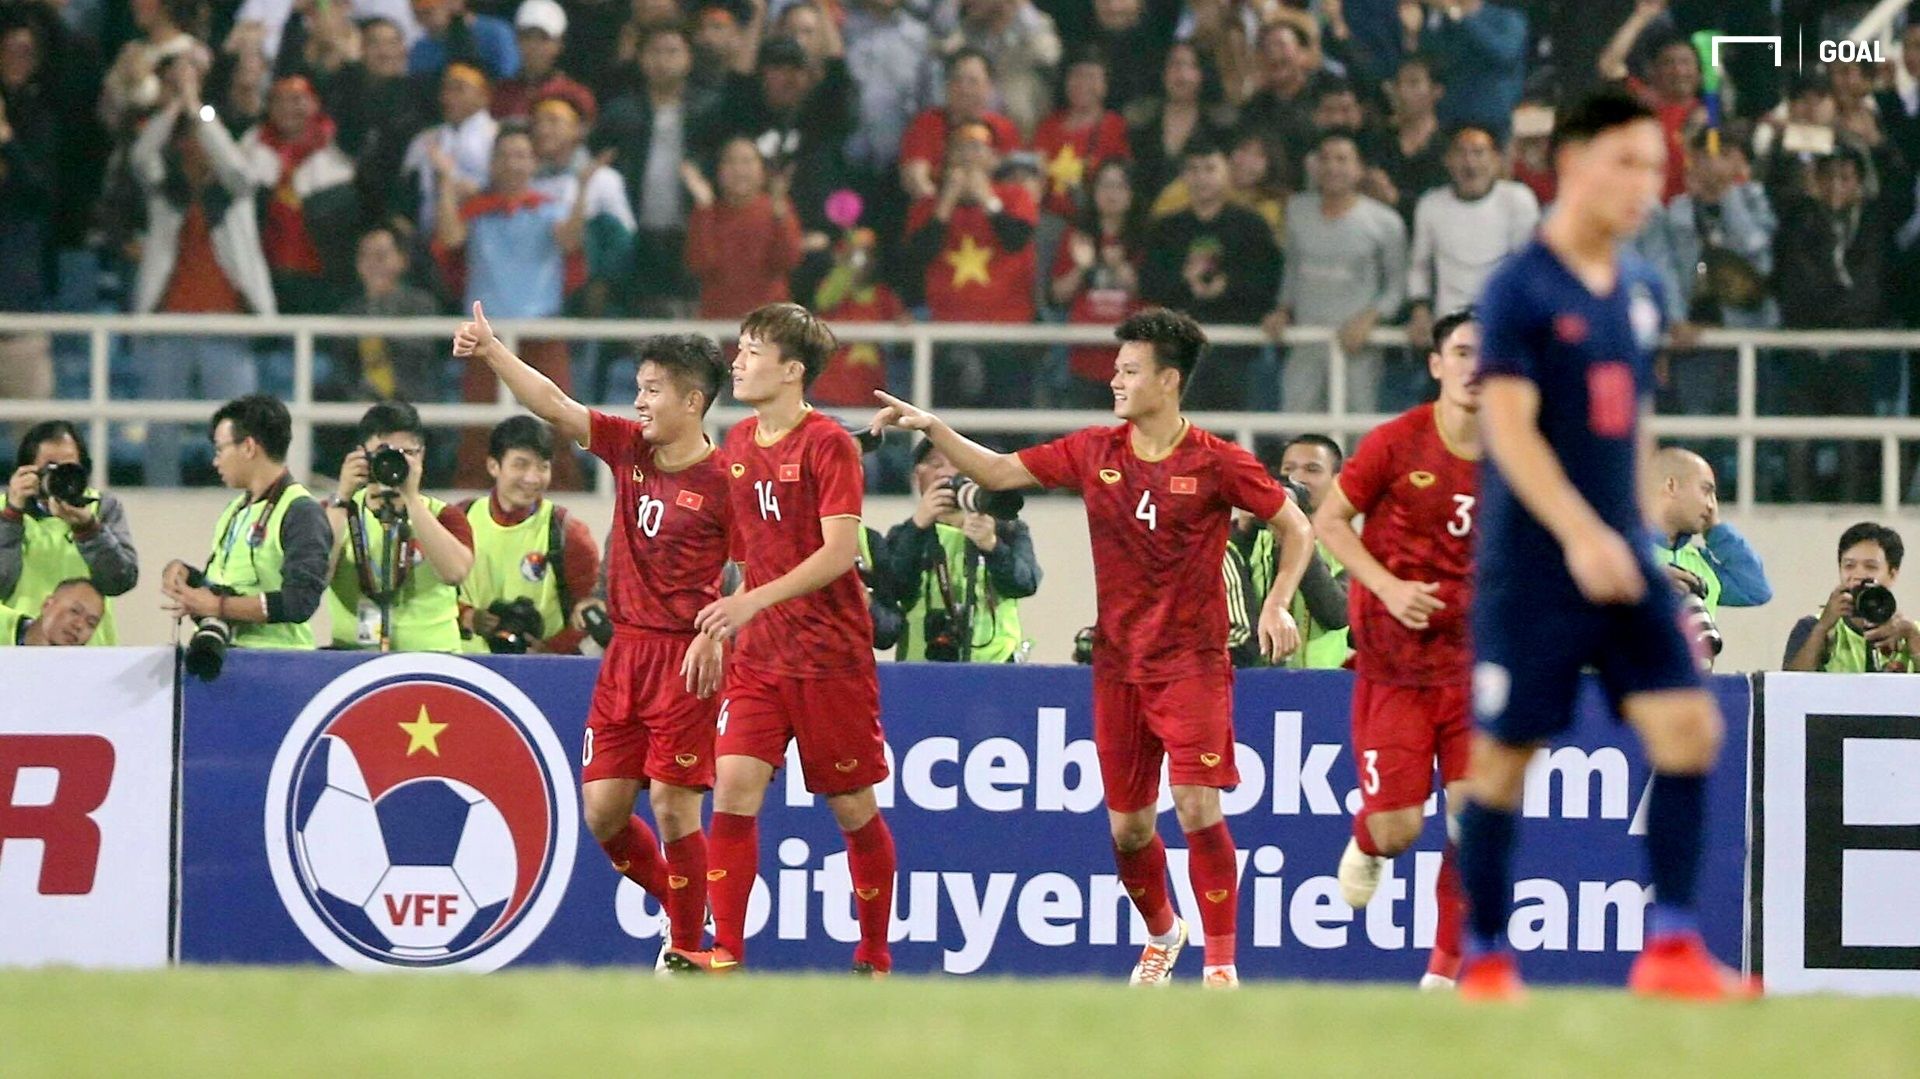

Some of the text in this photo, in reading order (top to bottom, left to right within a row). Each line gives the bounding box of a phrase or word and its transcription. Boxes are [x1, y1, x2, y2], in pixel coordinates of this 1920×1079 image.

[637, 494, 665, 538] 10
[754, 480, 782, 522] 14
[1135, 490, 1156, 530] 4
[1447, 493, 1476, 537] 3
[1363, 749, 1380, 796] 3
[383, 893, 459, 927] VFF
